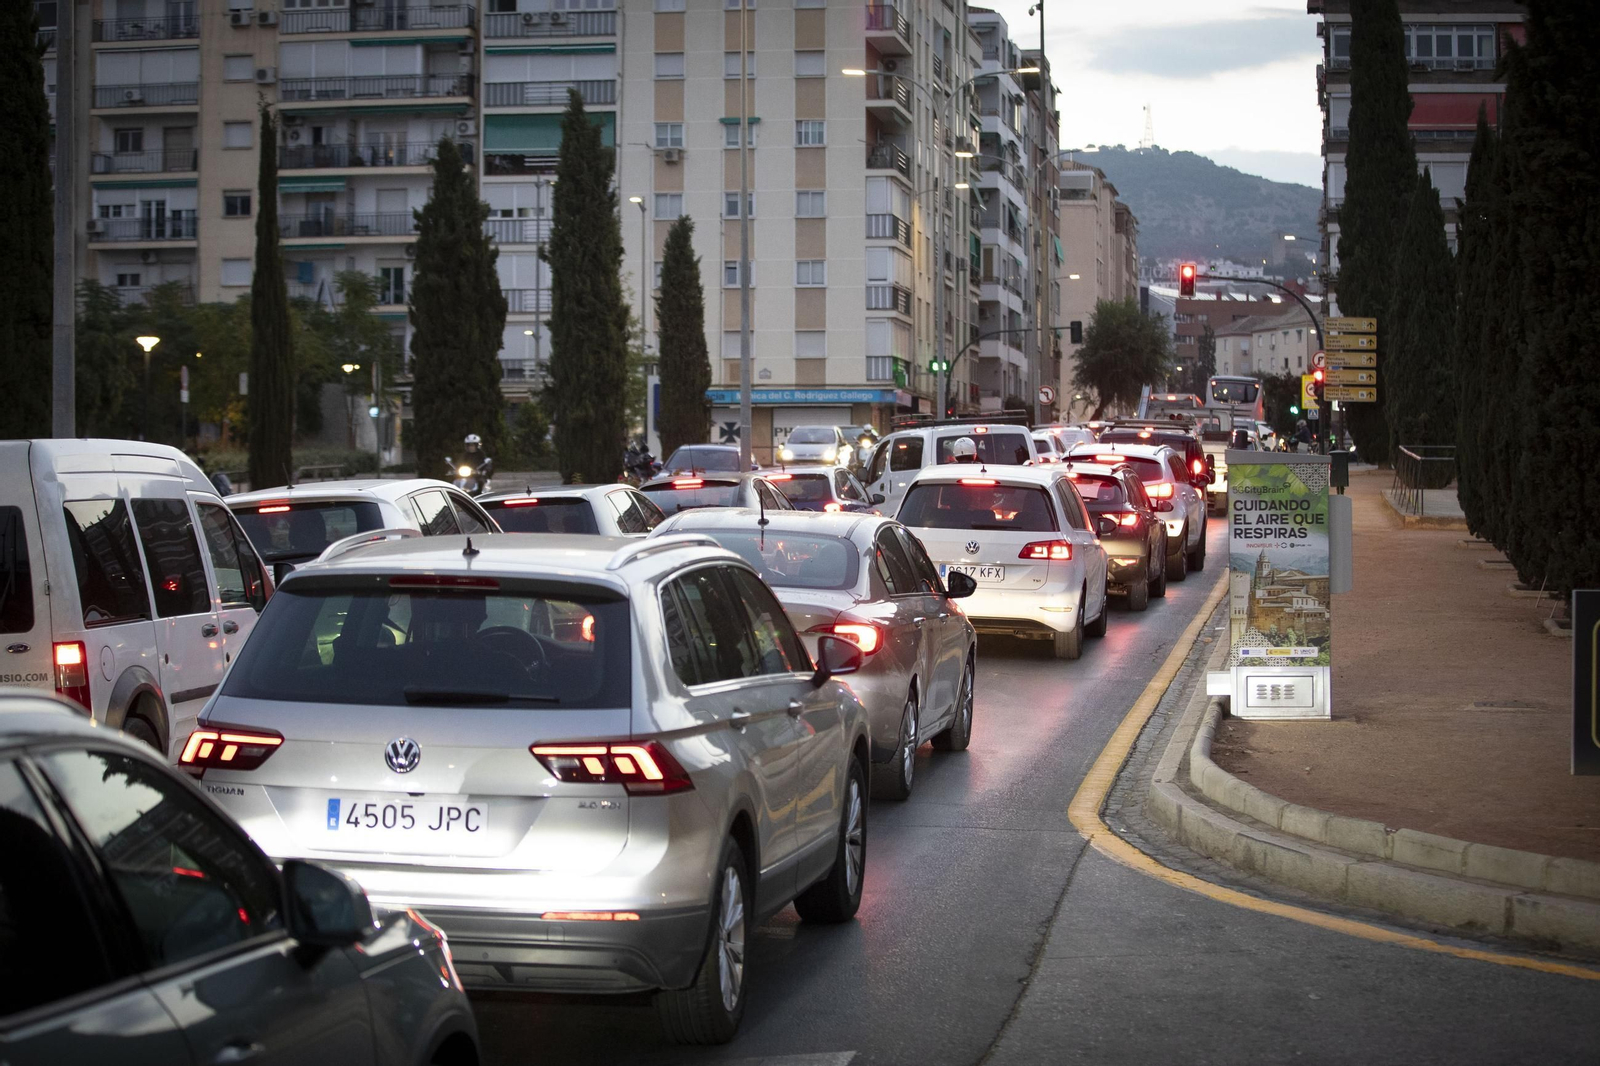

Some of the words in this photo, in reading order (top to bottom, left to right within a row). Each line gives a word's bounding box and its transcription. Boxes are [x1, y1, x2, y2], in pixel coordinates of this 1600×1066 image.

[736, 391, 767, 400] Mnica
[768, 391, 783, 400] del
[840, 391, 873, 402] Gallego
[774, 427, 793, 437] PH
[1233, 499, 1311, 511] CUIDANDO
[1234, 513, 1251, 525] EL
[1256, 513, 1289, 525] AIRE
[1293, 513, 1324, 526] QUE
[1233, 527, 1307, 539] RESPIRAS
[980, 567, 1001, 578] KFX
[206, 785, 245, 796] TIGUAN
[346, 802, 416, 830] 4505
[428, 806, 482, 833] JPC
